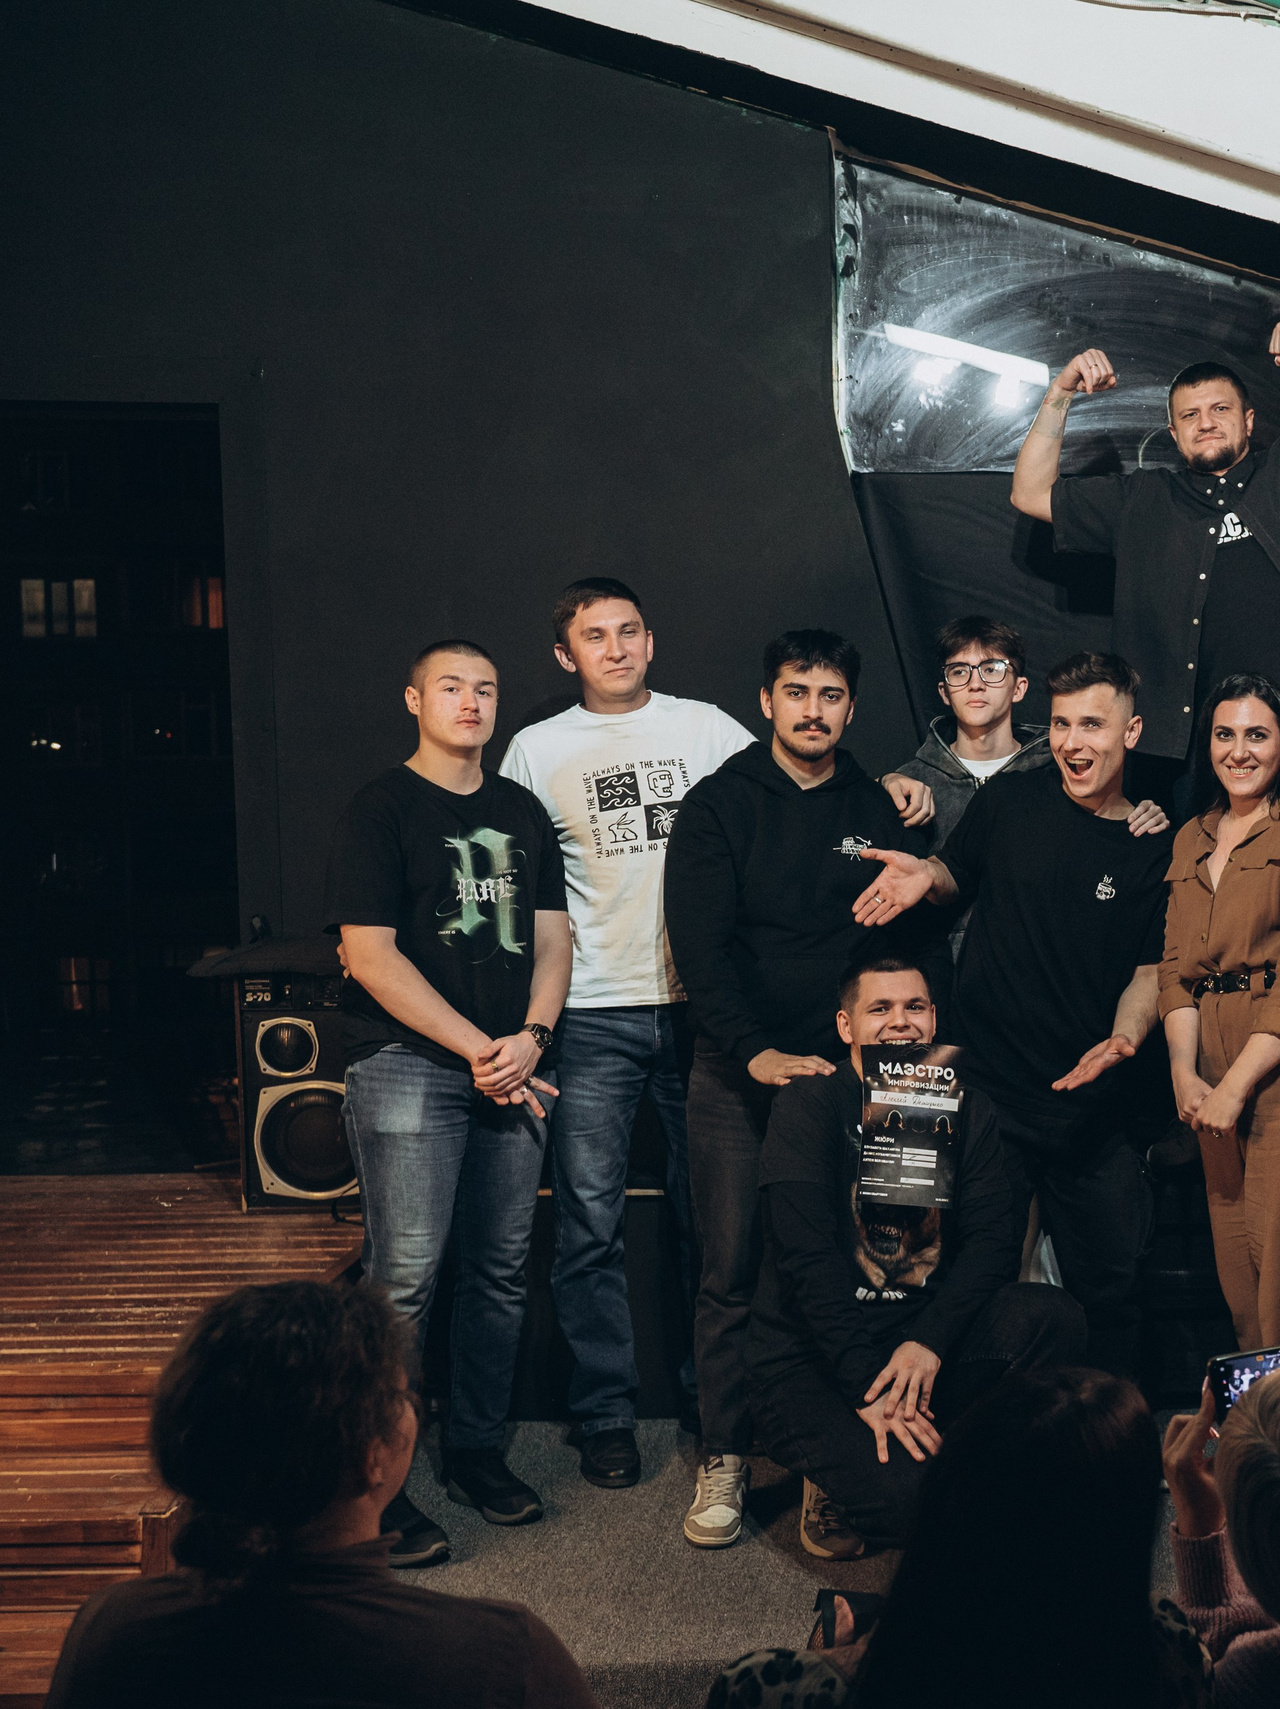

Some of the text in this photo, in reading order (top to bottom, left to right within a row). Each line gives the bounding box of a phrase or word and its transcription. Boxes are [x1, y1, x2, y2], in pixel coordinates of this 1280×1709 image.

[592, 759, 677, 778] ALWAYS ON THE WAVE
[583, 775, 604, 855] ALWAYS ON THE WAVE
[456, 875, 514, 904] RARE
[246, 992, 271, 1002] S-70
[879, 1061, 955, 1081] МАЭСТРО
[887, 1079, 949, 1092] ИМПРОВИЗАЦИИ
